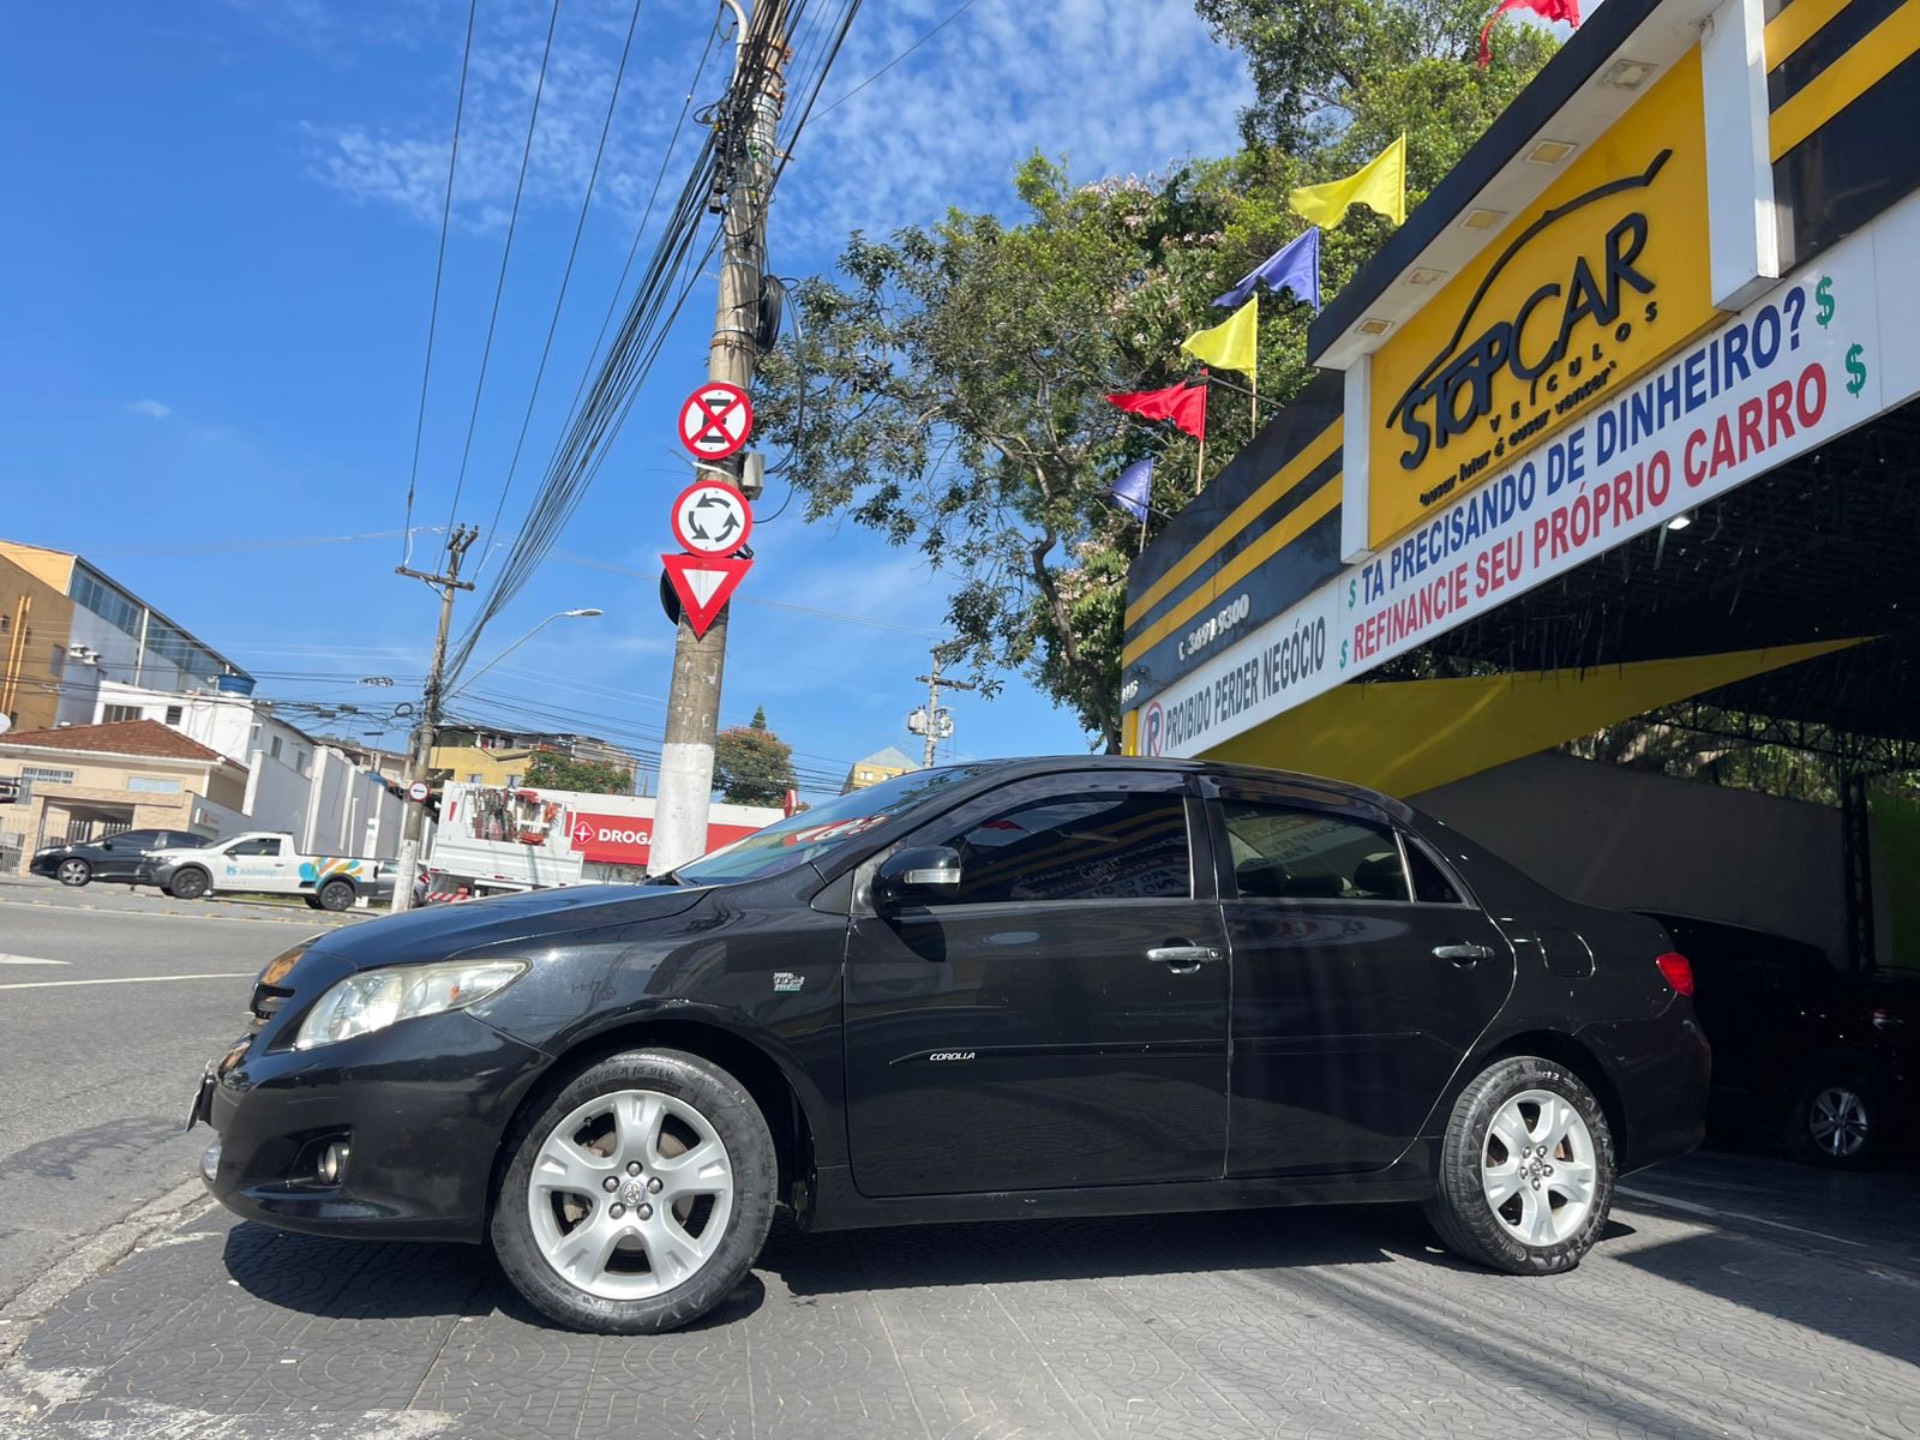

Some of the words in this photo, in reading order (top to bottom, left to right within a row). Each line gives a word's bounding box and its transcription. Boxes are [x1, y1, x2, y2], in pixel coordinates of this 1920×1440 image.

[1400, 212, 1656, 471] STOPCAR
[1353, 562, 1469, 663] REFINANCIE
[1475, 531, 1524, 598] SEU
[1534, 450, 1670, 568] PRÓPRIO
[1684, 362, 1827, 488] CARRO
[1361, 559, 1385, 605] TA
[1390, 461, 1536, 590] PRECISANDO
[1547, 427, 1585, 496] DE
[1597, 286, 1806, 467] DINHEIRO?
[1494, 437, 1505, 457] é
[1165, 685, 1211, 751] PROIBIDO
[1213, 657, 1259, 726] PERDER
[1262, 616, 1326, 700] NEGÓCIO
[598, 828, 653, 846] DROG
[929, 1052, 976, 1061] COROLLA
